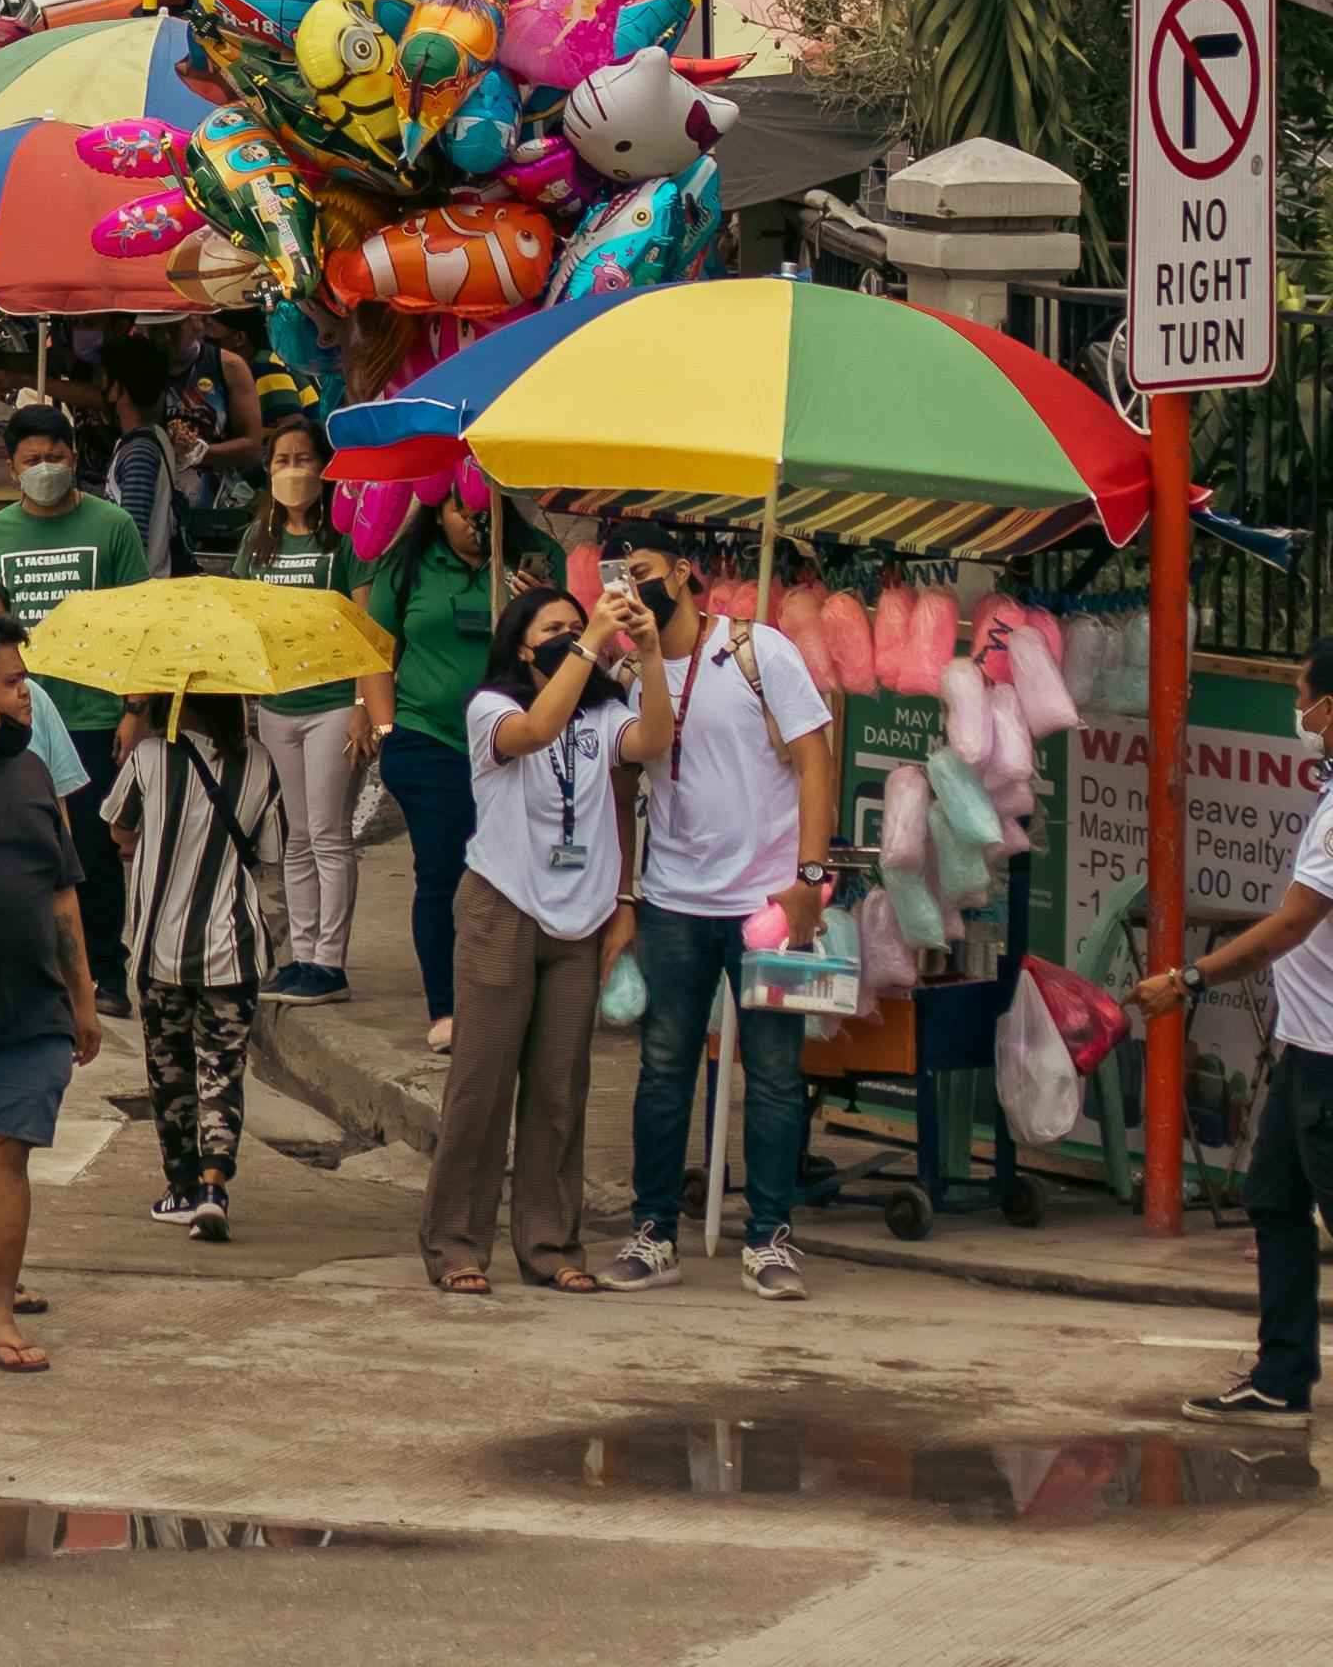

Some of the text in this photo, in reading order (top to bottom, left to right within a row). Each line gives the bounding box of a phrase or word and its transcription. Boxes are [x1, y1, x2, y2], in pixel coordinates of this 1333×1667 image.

[1182, 198, 1227, 243] NO
[1157, 257, 1252, 306] RIGHT
[1160, 318, 1245, 366] TURN
[15, 553, 80, 568] 1. FACEMASK
[24, 571, 81, 585] DISTANSYA
[895, 708, 933, 727] MAY
[864, 726, 922, 750] DAPAT
[1080, 776, 1117, 807] Do
[1188, 798, 1257, 829] eave
[1196, 828, 1292, 874] Penalty:
[1242, 880, 1272, 904] or
